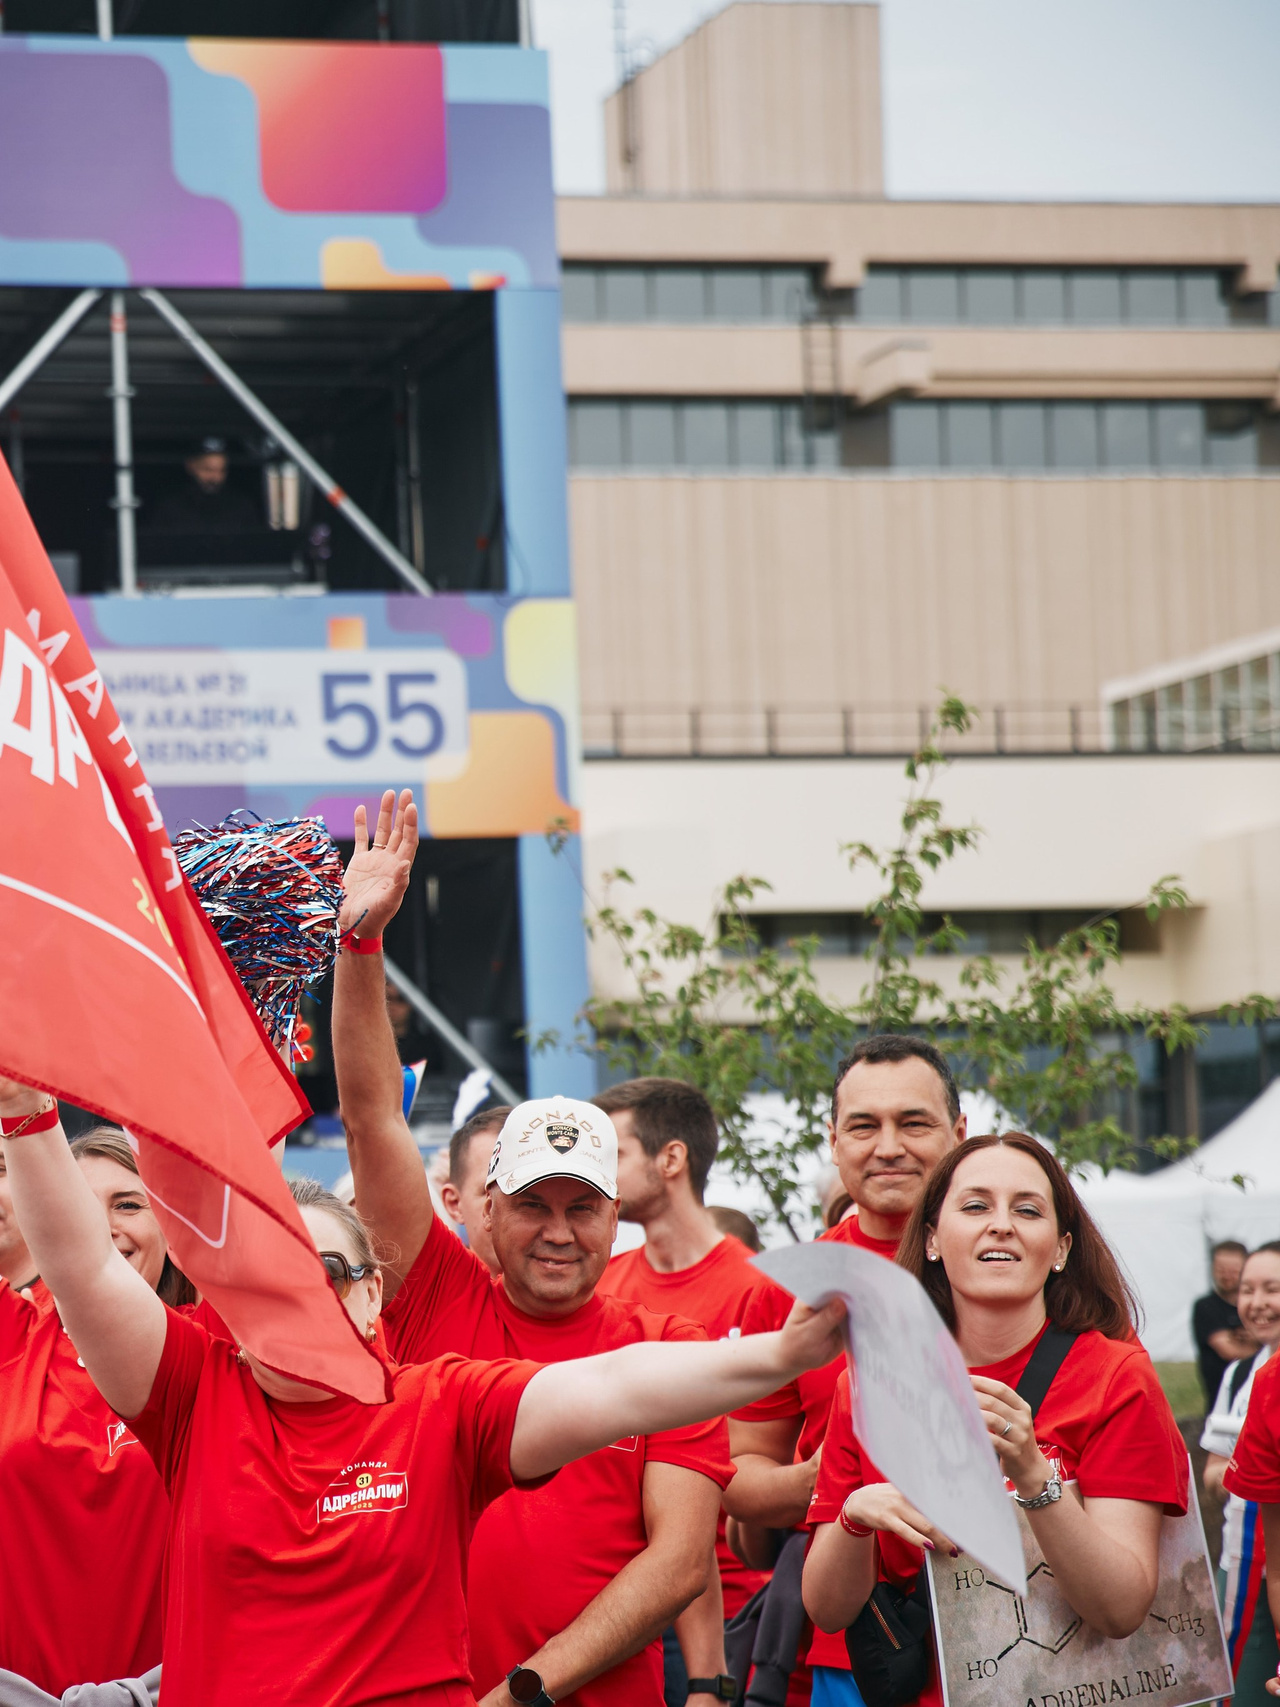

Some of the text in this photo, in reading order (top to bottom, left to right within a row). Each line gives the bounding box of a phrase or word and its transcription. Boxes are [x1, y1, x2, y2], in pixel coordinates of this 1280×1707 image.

[145, 706, 297, 730] АКАДЕМИКА
[321, 672, 445, 760] 55
[518, 1111, 602, 1149] MONACO
[517, 1146, 547, 1159] MONTE
[340, 1461, 388, 1476] КОМАНДА
[358, 1475, 369, 1485] 31
[322, 1482, 404, 1512] АДРЕНАЛИН
[352, 1502, 373, 1510] 2025
[954, 1567, 986, 1591] HO
[1167, 1615, 1206, 1637] CH3
[966, 1658, 999, 1681] HO
